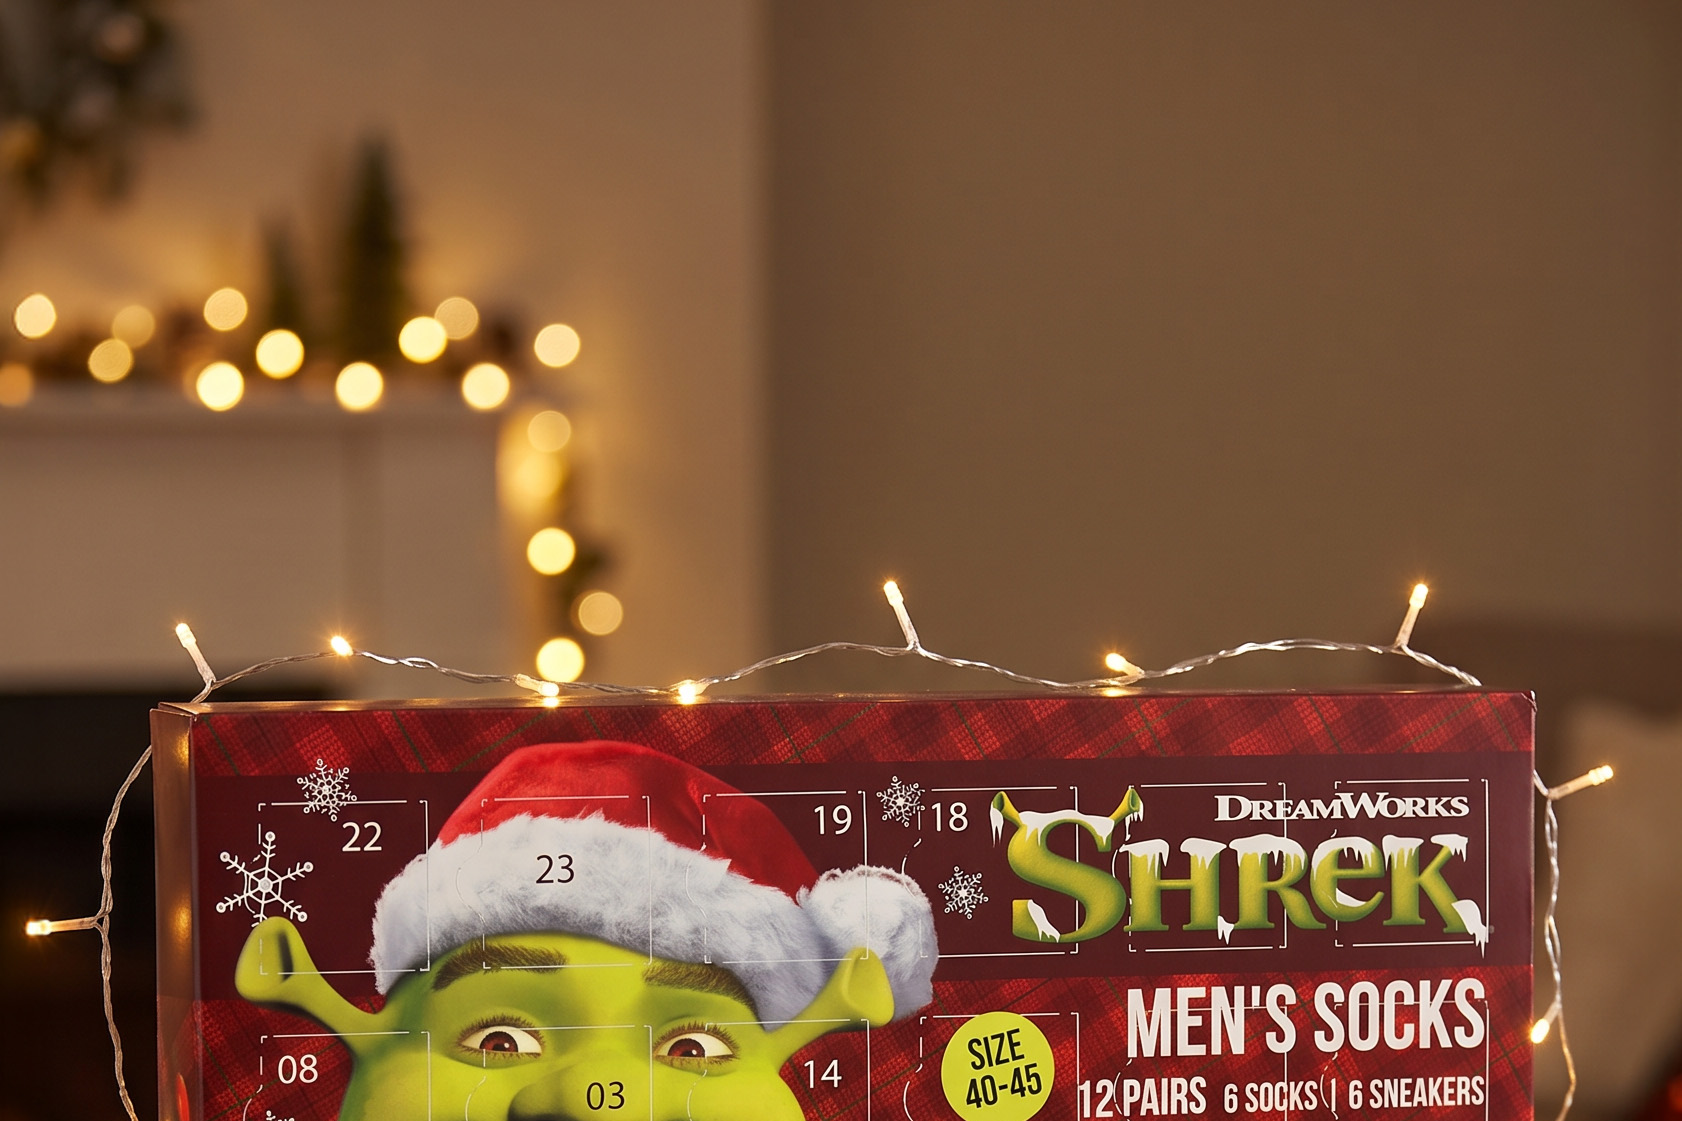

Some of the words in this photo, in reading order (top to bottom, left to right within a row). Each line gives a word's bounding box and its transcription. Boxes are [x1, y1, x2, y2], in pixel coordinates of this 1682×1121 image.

[812, 804, 853, 836] 19
[930, 802, 969, 832] 18
[341, 821, 383, 853] 22
[535, 853, 576, 885] 23
[1127, 983, 1297, 1059] MEN'S
[1314, 978, 1486, 1053] SOCKS
[967, 1029, 1026, 1071] SIZE
[277, 1054, 319, 1086] 08
[804, 1059, 843, 1089] 14
[585, 1081, 626, 1111] 03
[965, 1063, 1043, 1110] 40-45
[1079, 1080, 1114, 1118] 12
[1123, 1077, 1207, 1116] PAIRS
[1223, 1083, 1239, 1113] 6
[1244, 1081, 1319, 1112] SOCKS
[1348, 1079, 1364, 1109] 6
[1369, 1076, 1486, 1108] SNEAKERS
